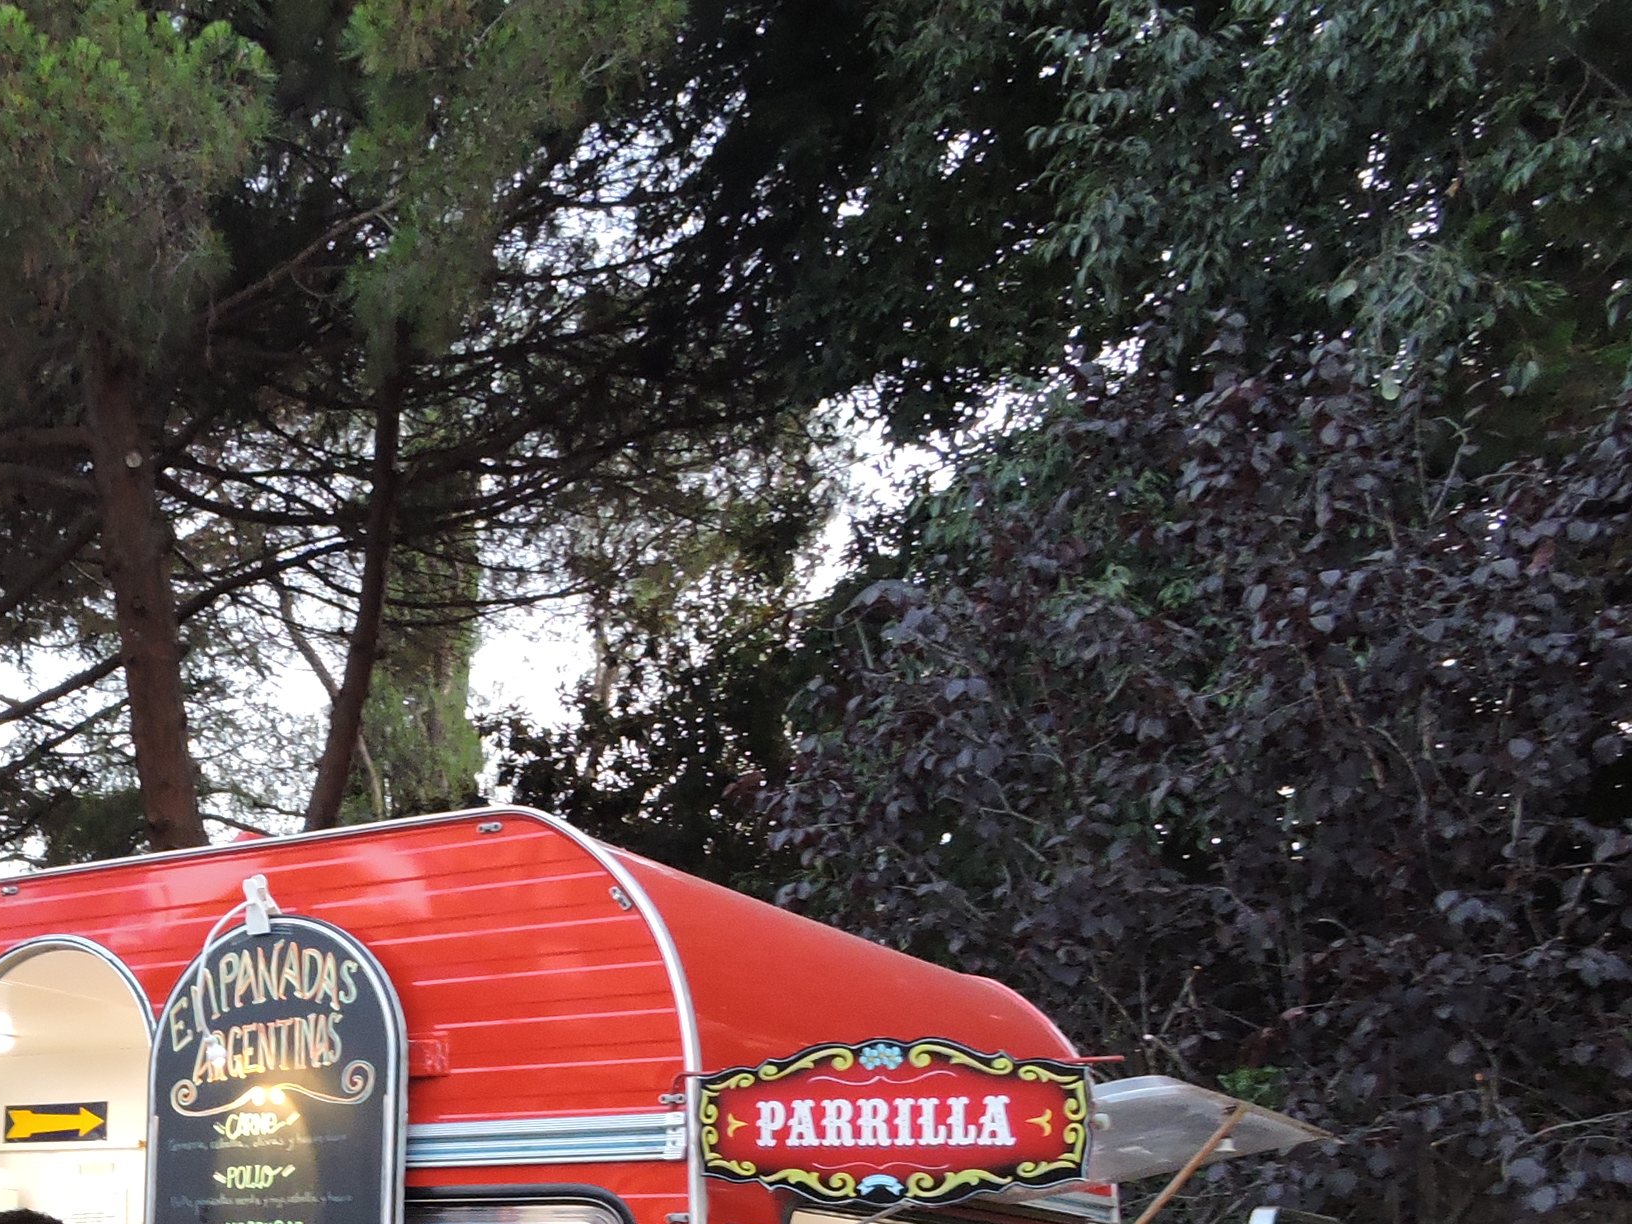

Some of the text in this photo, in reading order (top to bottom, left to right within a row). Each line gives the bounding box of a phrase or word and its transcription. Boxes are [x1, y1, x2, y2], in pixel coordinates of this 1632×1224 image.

[170, 939, 358, 1052] EMPANADAS
[192, 1012, 344, 1086] ARGENTINAS
[755, 1096, 1016, 1148] PARRILLA
[226, 1165, 283, 1189] POLLO
